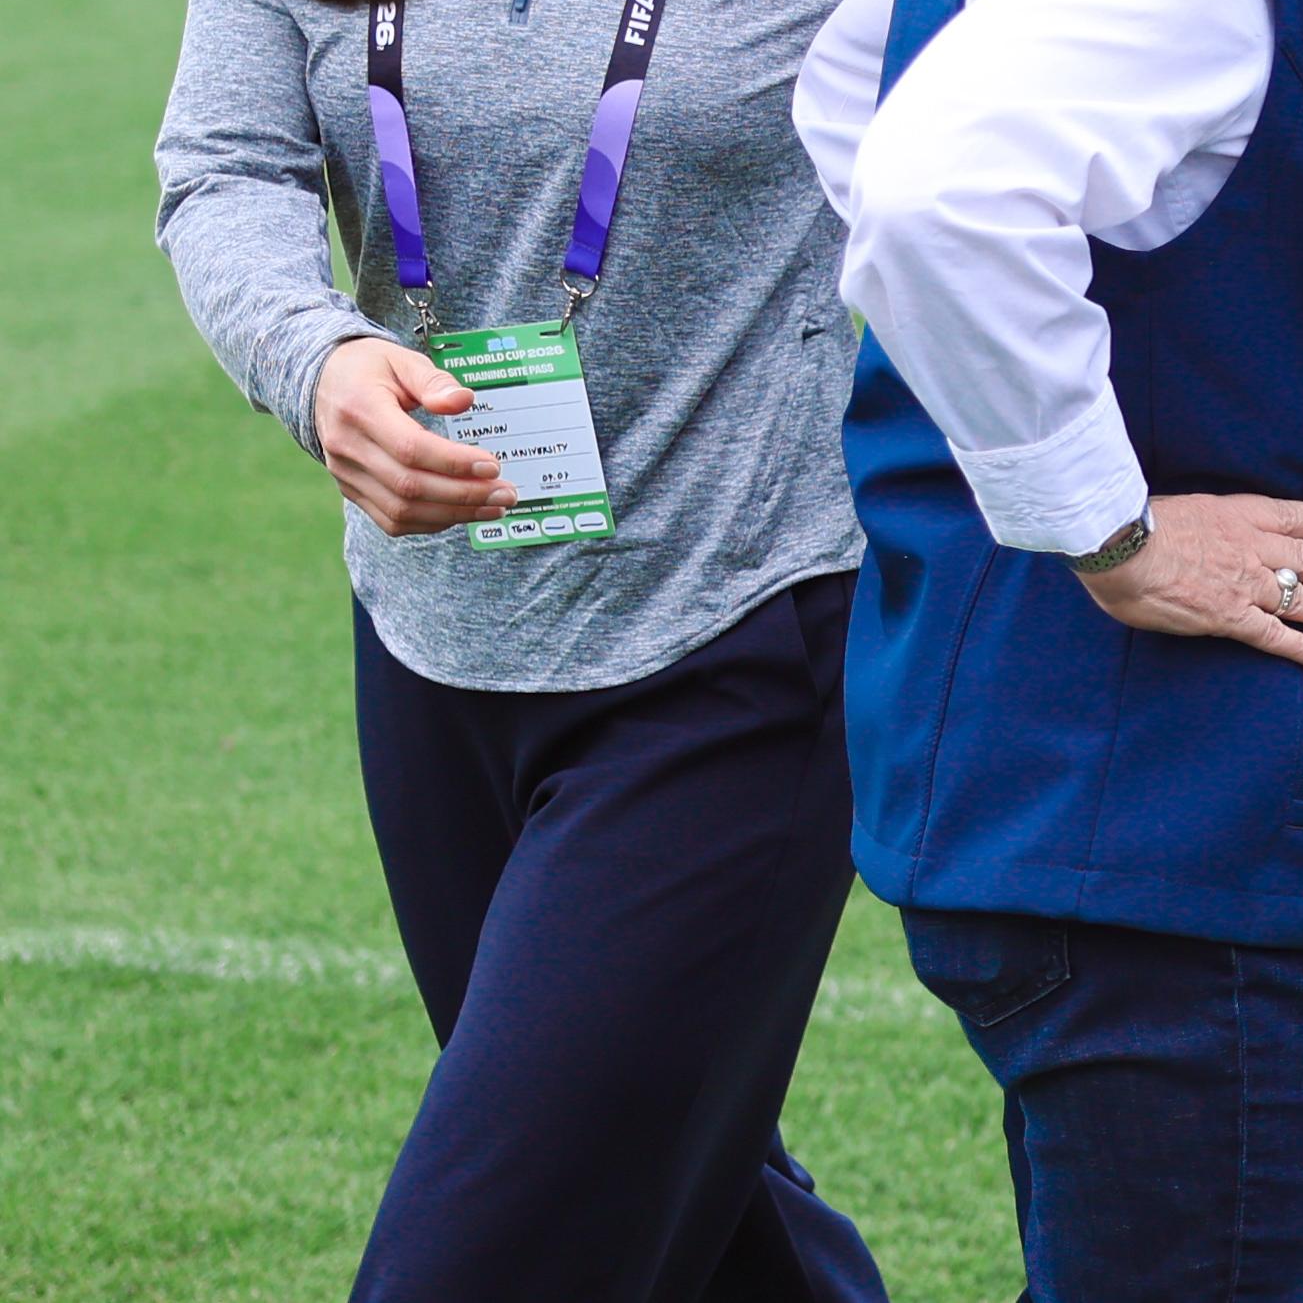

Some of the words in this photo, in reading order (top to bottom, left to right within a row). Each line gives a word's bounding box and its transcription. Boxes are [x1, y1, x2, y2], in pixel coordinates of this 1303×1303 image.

[444, 355, 467, 369] FIFA
[466, 352, 505, 366] WORLD
[505, 350, 526, 361] CUP
[527, 346, 564, 357] 2026
[462, 369, 507, 383] TRAINING
[508, 366, 529, 378] SITE
[529, 363, 555, 375] PASS
[457, 423, 508, 439] SHANNON
[511, 443, 568, 458] UNIVERSITY
